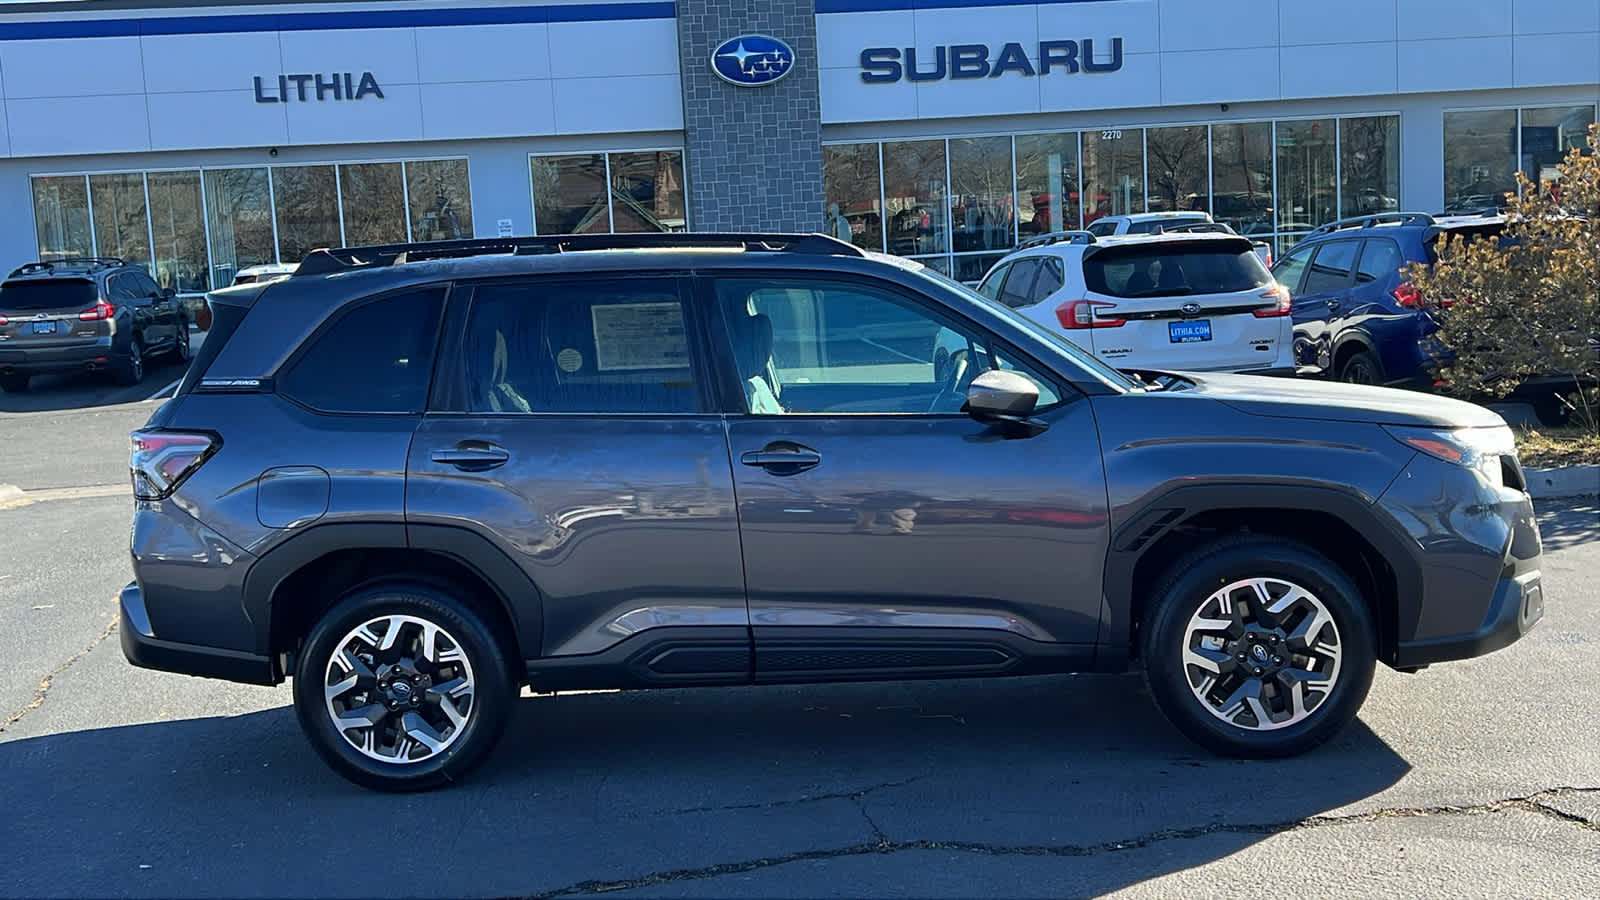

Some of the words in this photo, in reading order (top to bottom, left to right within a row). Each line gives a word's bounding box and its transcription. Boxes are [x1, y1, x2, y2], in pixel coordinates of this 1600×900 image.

[860, 37, 1123, 84] SUBARU
[253, 72, 385, 103] LITHIA
[1102, 130, 1121, 140] 2270
[1171, 326, 1210, 336] LITHIA.COM
